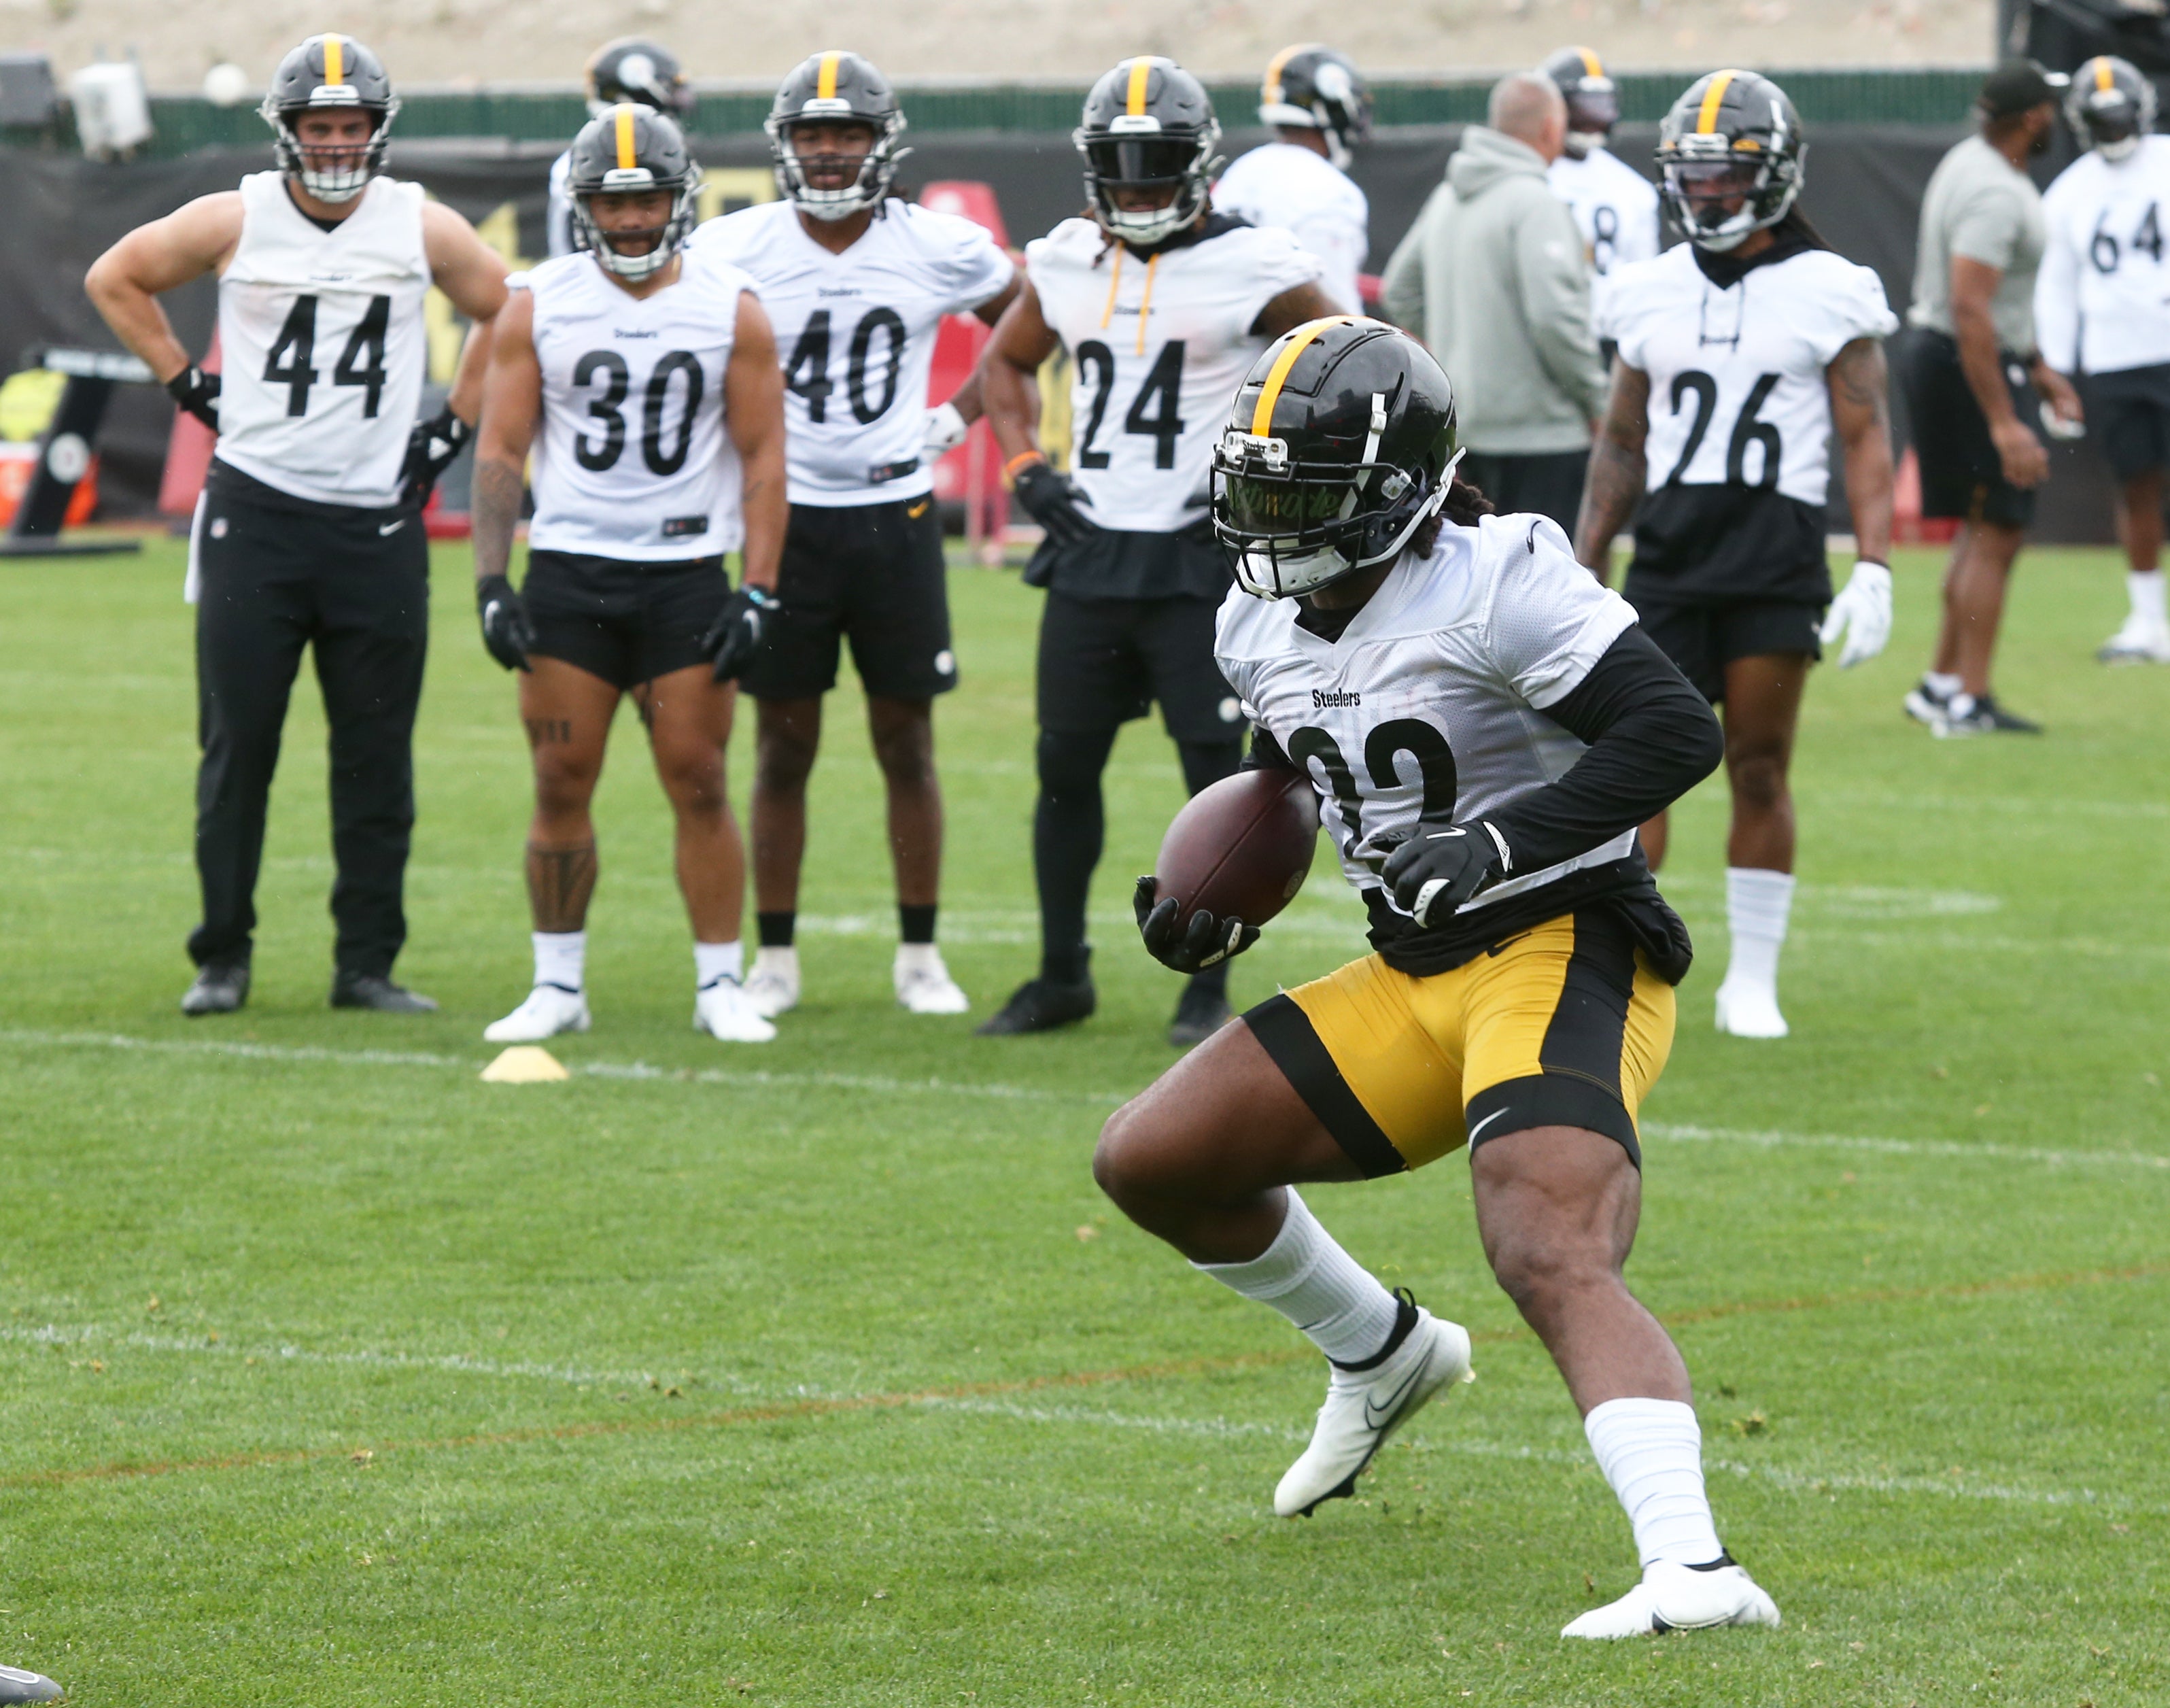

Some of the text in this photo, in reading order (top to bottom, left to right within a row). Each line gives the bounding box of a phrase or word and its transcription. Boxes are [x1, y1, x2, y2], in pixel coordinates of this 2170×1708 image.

[1594, 205, 1618, 275] 8
[2089, 202, 2162, 273] 64
[263, 294, 392, 418] 44
[574, 351, 704, 476] 30
[785, 307, 907, 424] 40
[1077, 340, 1186, 470] 24
[1670, 371, 1783, 488] 26
[1312, 687, 1360, 708] Steelers
